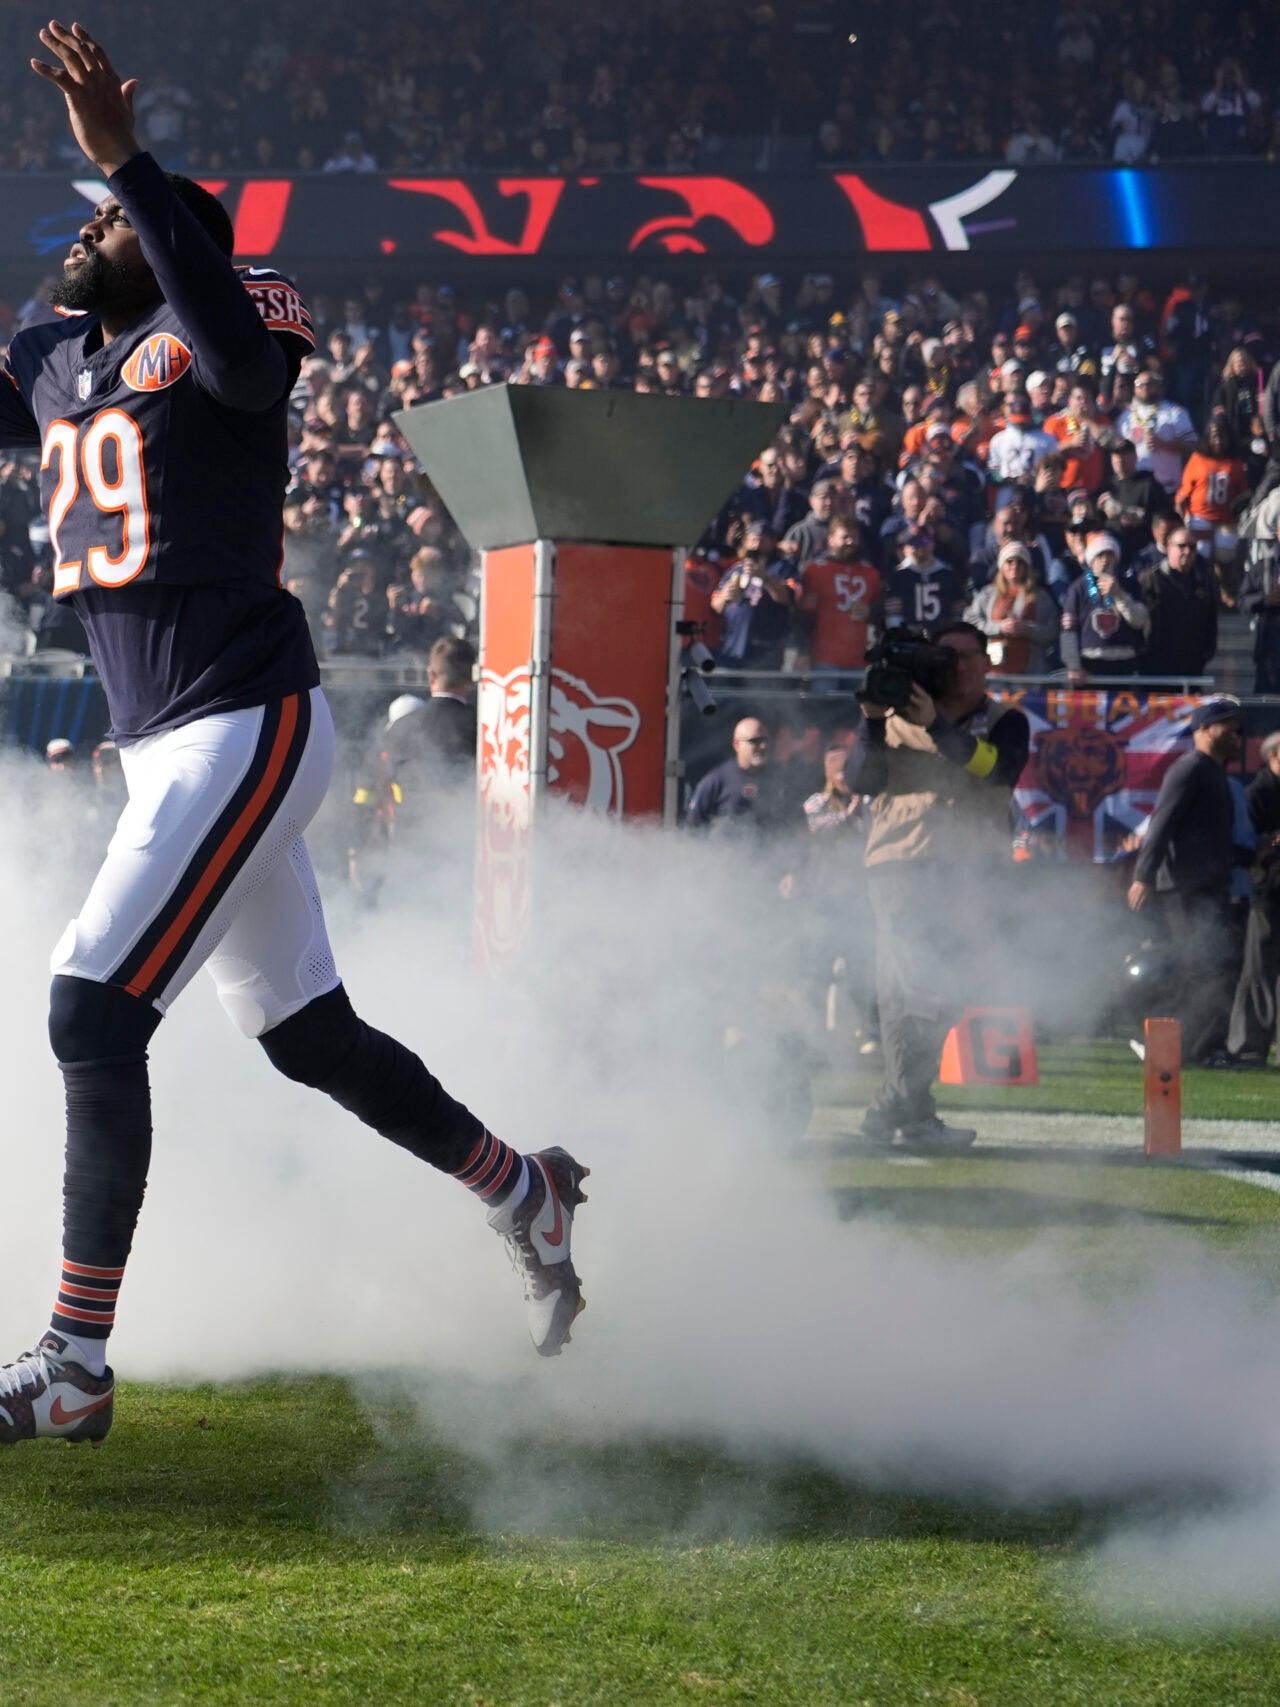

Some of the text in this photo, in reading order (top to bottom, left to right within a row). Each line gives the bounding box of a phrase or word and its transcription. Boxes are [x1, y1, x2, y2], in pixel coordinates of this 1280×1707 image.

[249, 288, 302, 325] GSH
[40, 408, 150, 597] 29
[1207, 471, 1230, 506] 18
[834, 573, 868, 612] 52
[914, 582, 941, 622] 15
[969, 1015, 1023, 1079] G
